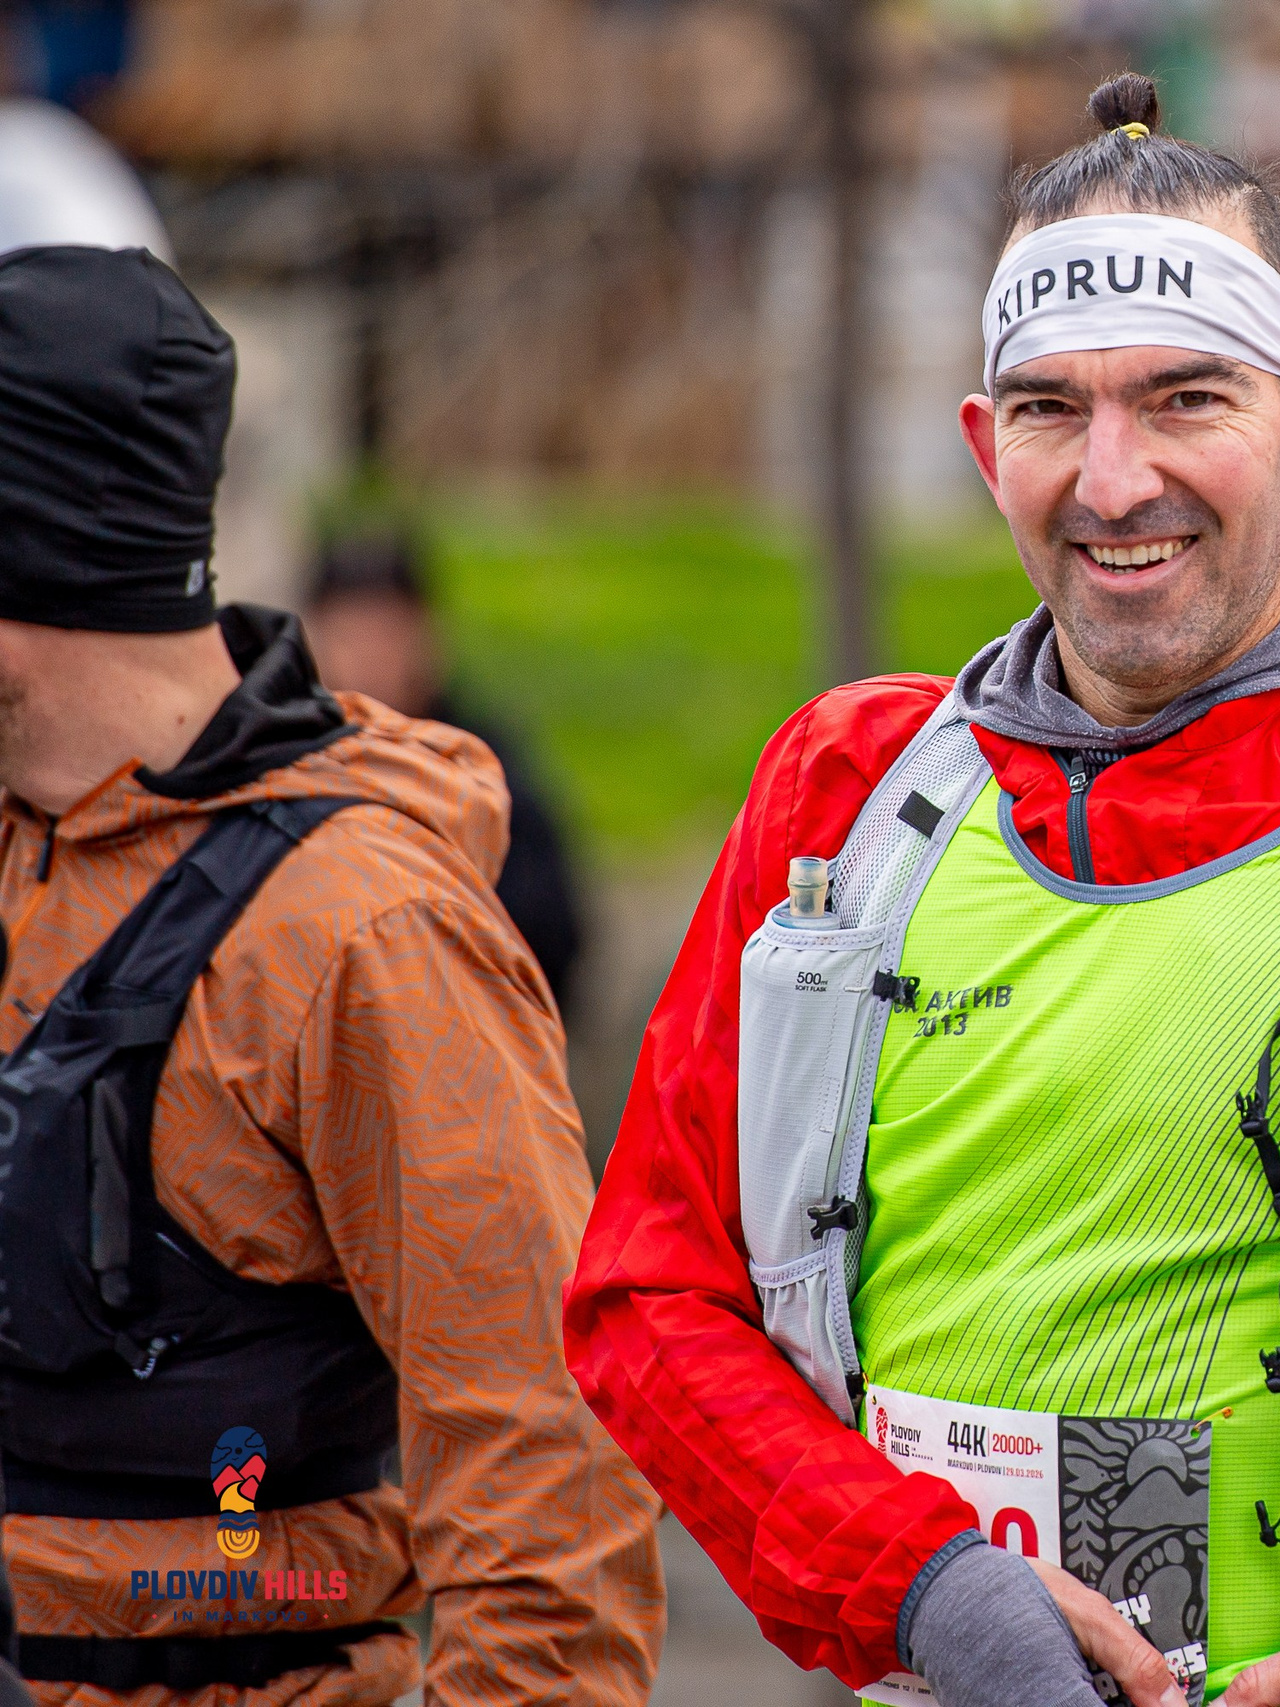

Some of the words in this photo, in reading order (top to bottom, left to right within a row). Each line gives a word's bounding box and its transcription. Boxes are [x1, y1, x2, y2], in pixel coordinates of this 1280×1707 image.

[997, 255, 1194, 334] KIPRUN
[913, 1011, 970, 1038] 2013
[890, 1423, 921, 1443] PLOVDIV
[947, 1420, 987, 1458] 44K
[992, 1433, 1044, 1456] 2000D+
[890, 1440, 910, 1457] HILLS
[947, 1458, 974, 1472] MARKOVO
